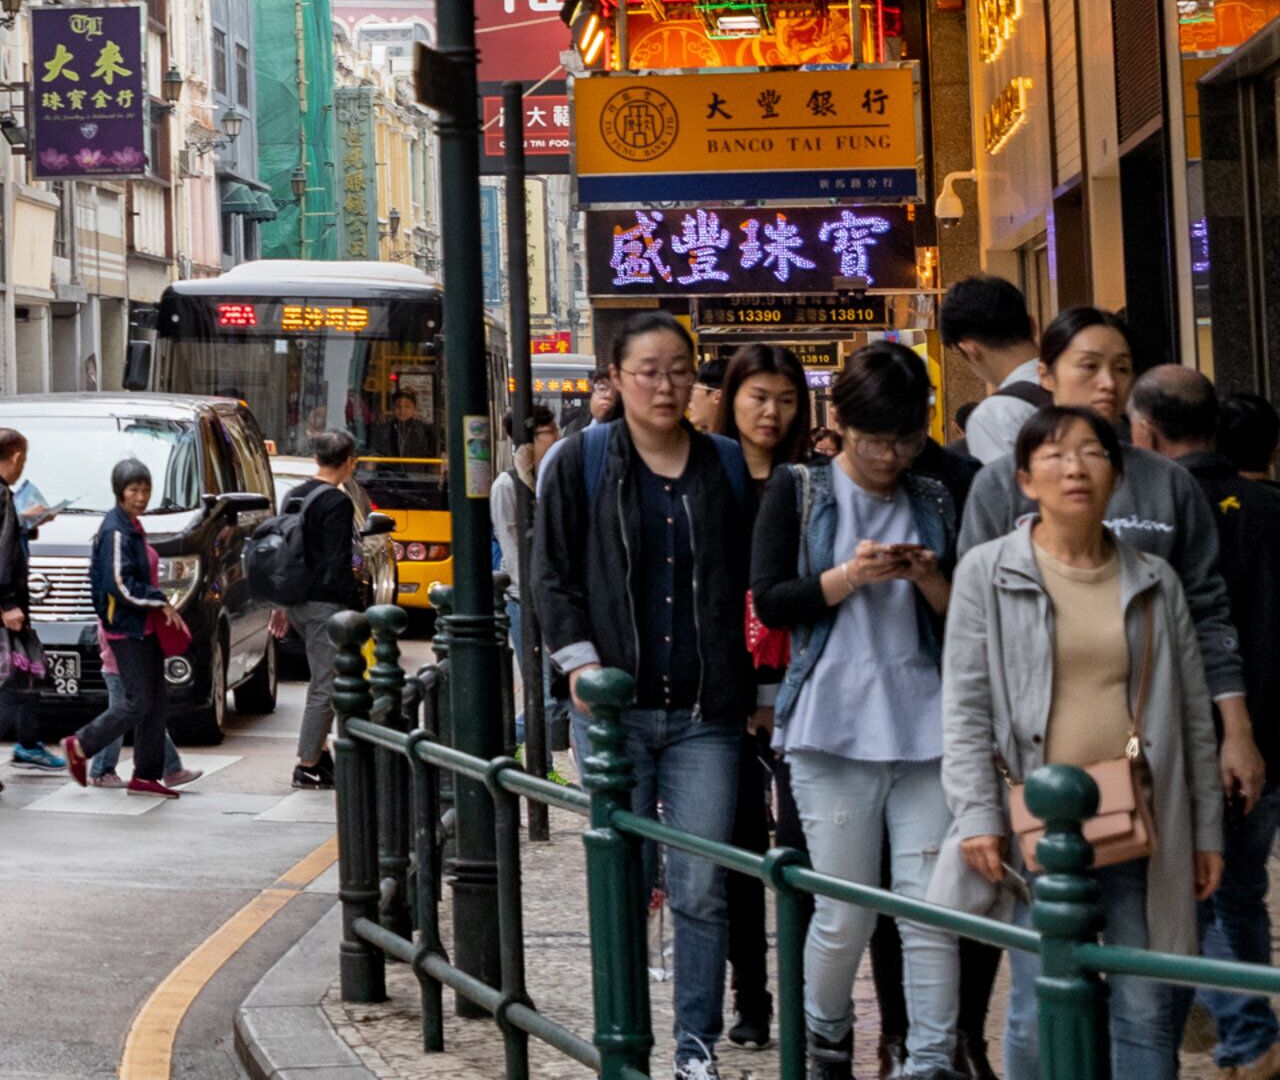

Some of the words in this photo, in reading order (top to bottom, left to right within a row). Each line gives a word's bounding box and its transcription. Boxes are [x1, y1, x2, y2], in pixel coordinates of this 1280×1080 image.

[706, 88, 889, 120] 大豐銀行
[499, 106, 570, 128] 大福
[529, 140, 545, 148] TAI
[707, 138, 773, 153] BANCO
[787, 137, 822, 152] TAI
[836, 135, 891, 150] FUNG
[609, 208, 891, 286] 盛豐珠寶
[738, 309, 782, 322] 13390
[829, 308, 874, 321] 13810
